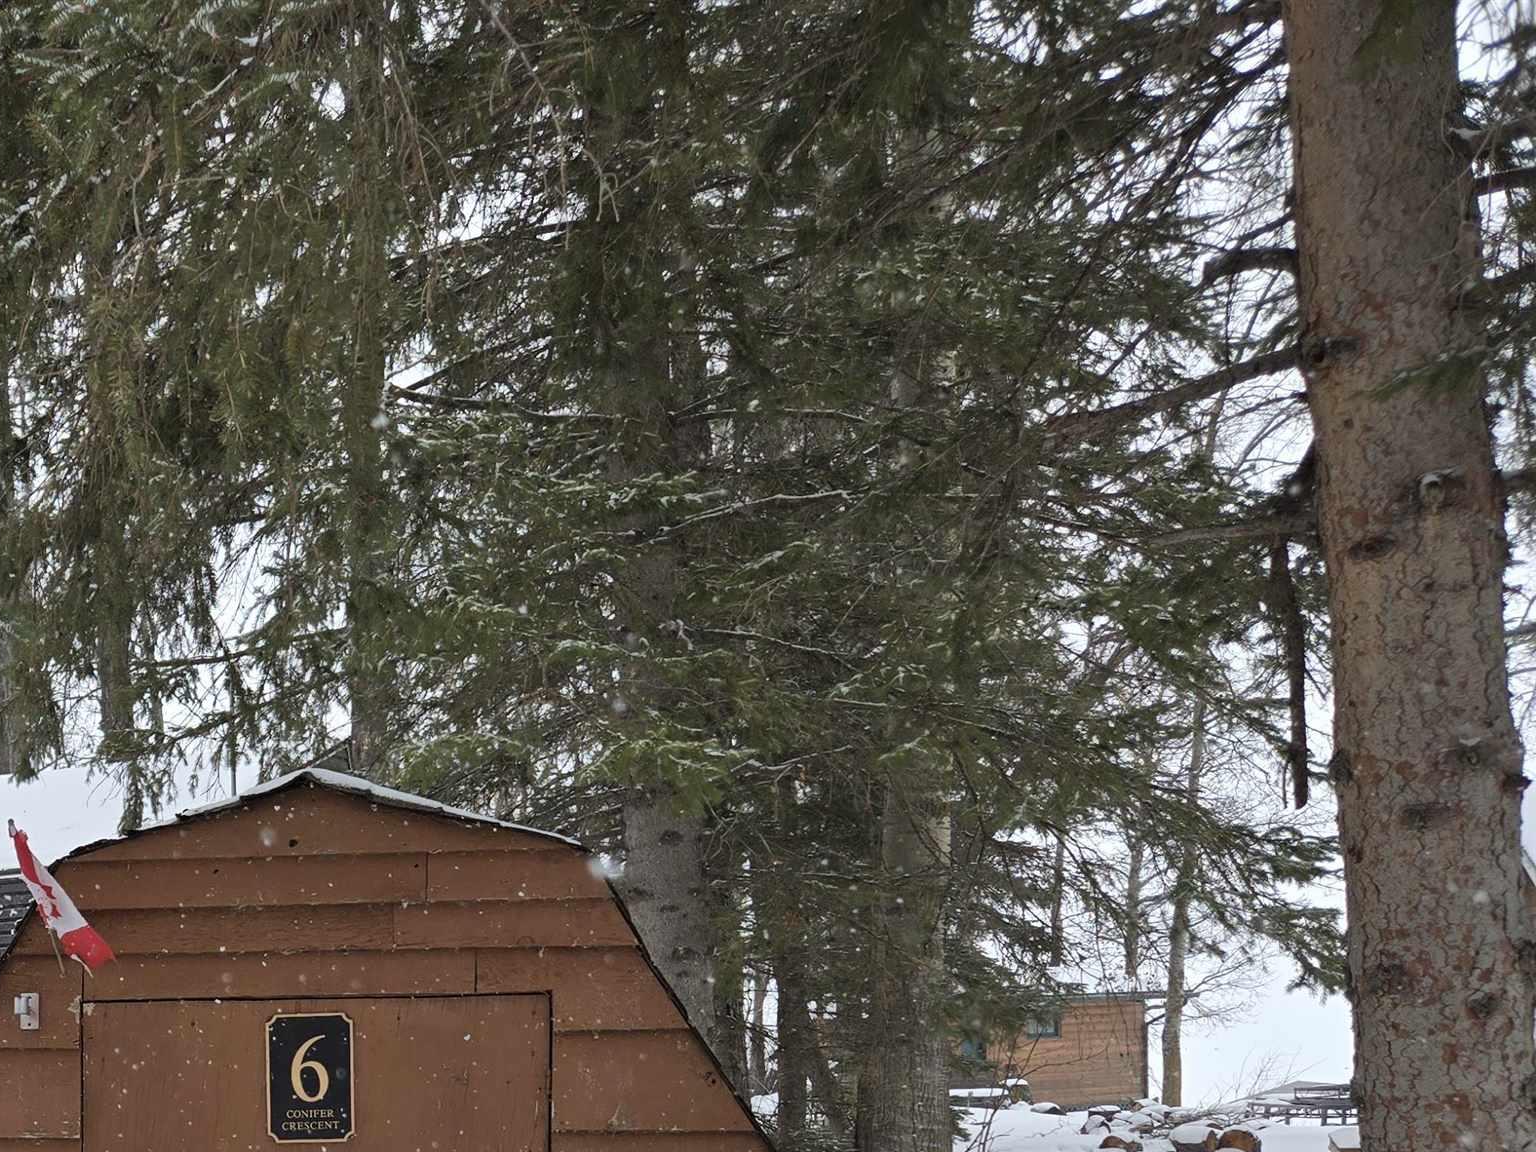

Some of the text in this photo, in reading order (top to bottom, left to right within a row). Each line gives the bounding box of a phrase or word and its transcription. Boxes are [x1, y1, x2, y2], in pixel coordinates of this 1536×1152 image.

[291, 1034, 329, 1103] 6
[286, 1108, 334, 1119] CONIFER
[281, 1120, 340, 1132] CRESCENT
